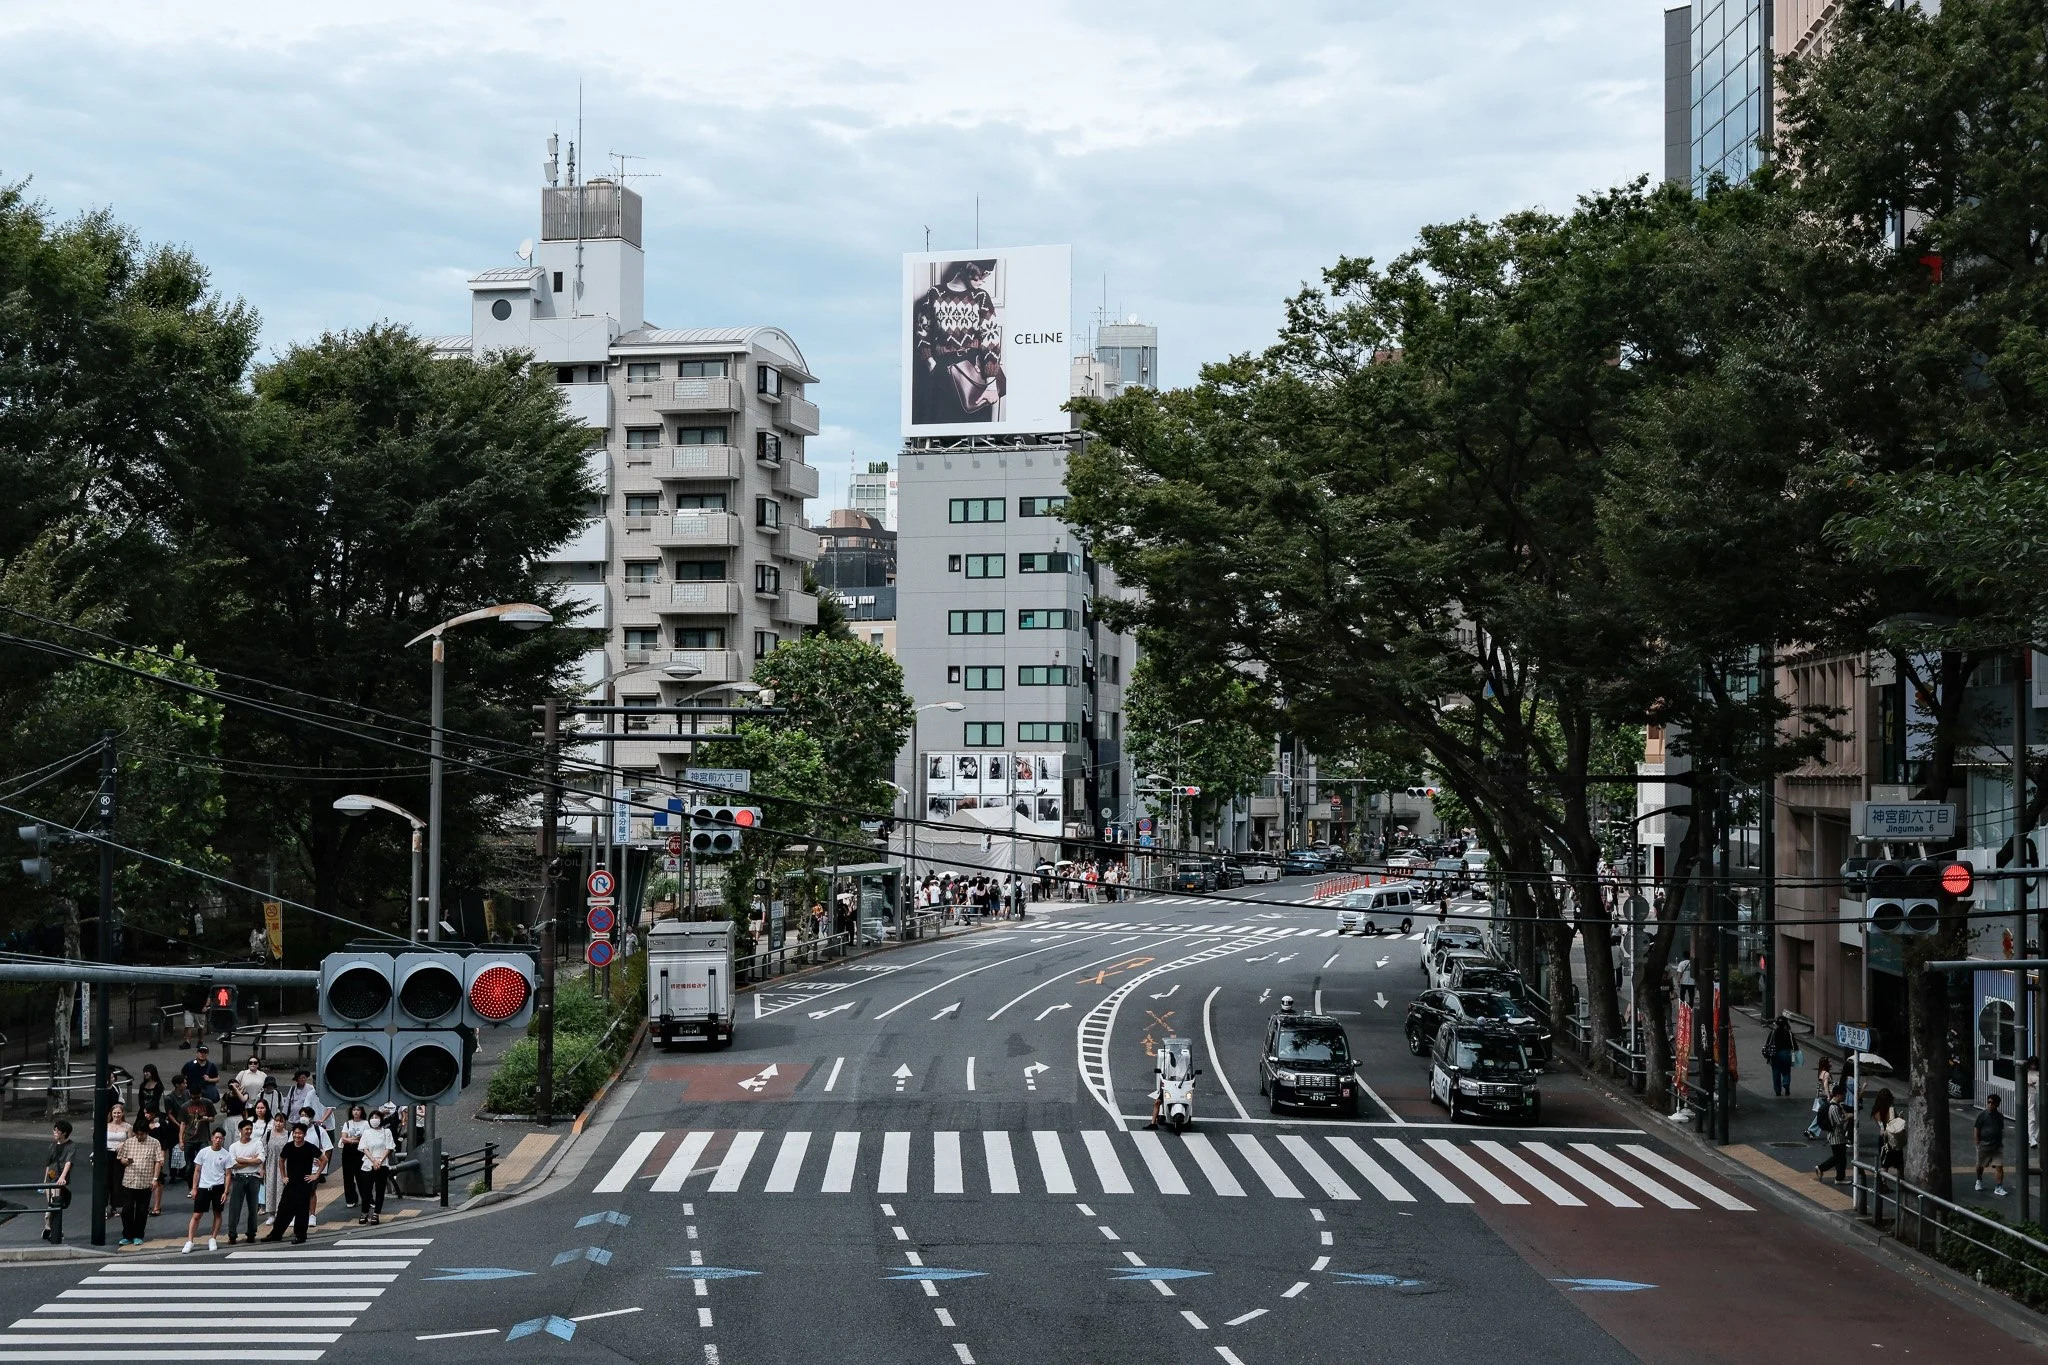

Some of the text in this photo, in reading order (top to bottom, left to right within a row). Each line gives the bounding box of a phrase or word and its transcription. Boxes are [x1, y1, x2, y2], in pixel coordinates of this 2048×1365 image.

[1014, 332, 1063, 345] CELINE
[690, 771, 743, 783] 神宮前六丁目
[1872, 809, 1949, 824] 神宮前六丁目
[1886, 824, 1935, 834] Jingumae 6
